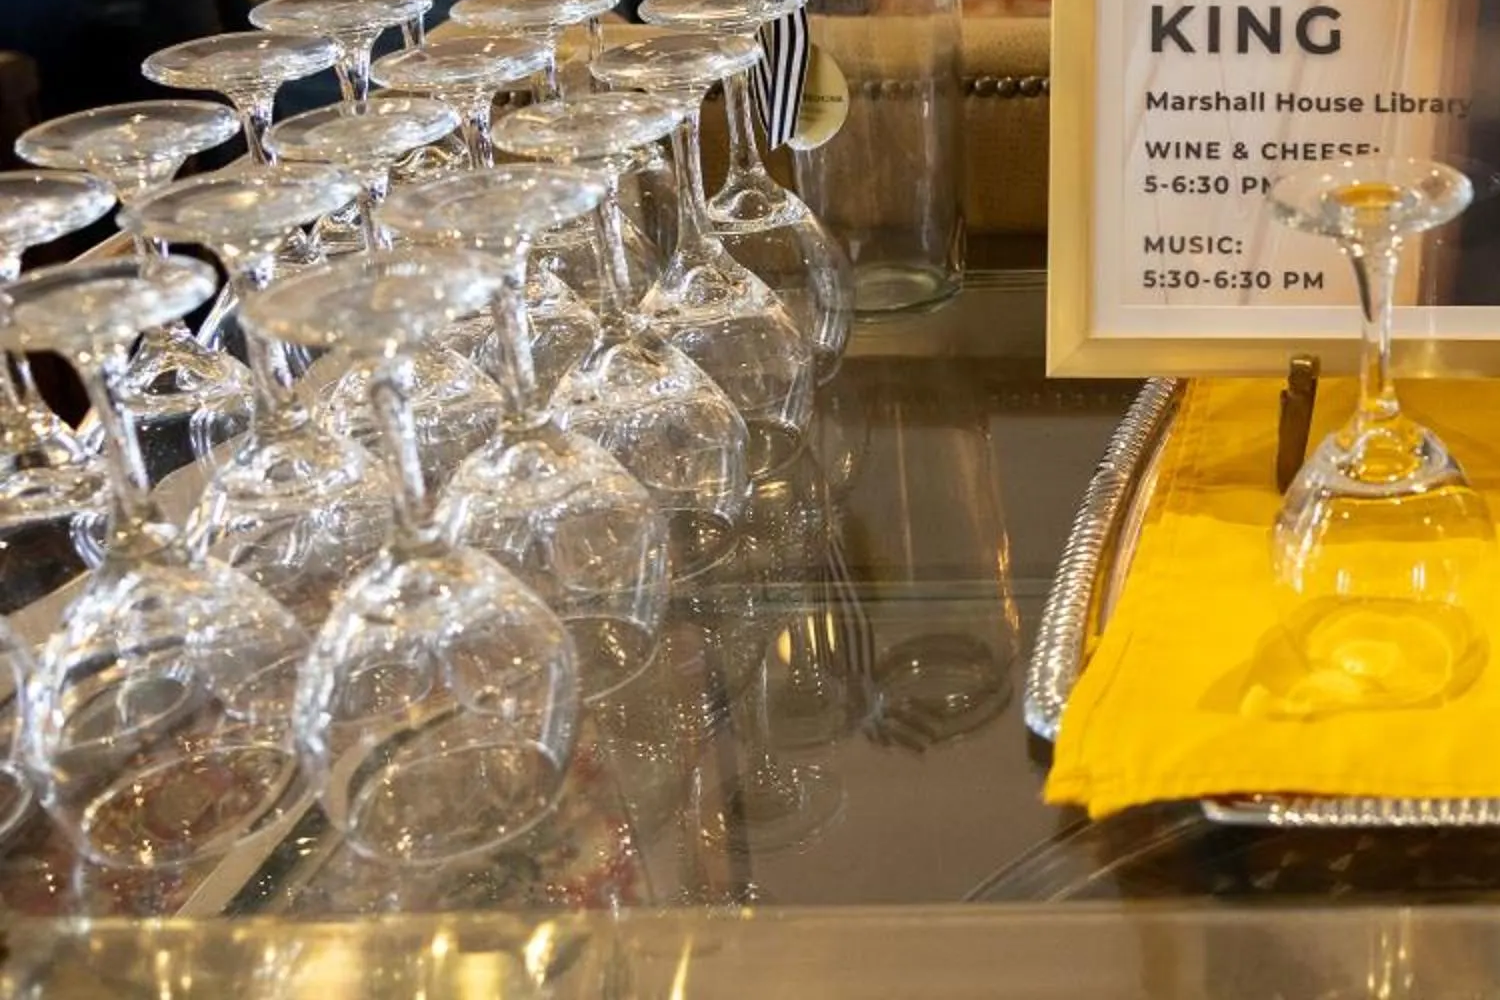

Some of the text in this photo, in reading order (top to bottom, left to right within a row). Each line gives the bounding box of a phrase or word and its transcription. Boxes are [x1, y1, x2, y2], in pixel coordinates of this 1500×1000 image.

[1151, 5, 1342, 55] KING
[1145, 91, 1473, 119] Marshall House Library
[1145, 141, 1221, 160] WINE
[1232, 141, 1249, 160] &
[1144, 176, 1230, 195] 5-6:30
[1144, 236, 1243, 255] MUSIC:
[1143, 270, 1325, 290] 5:30-6:30 PM
